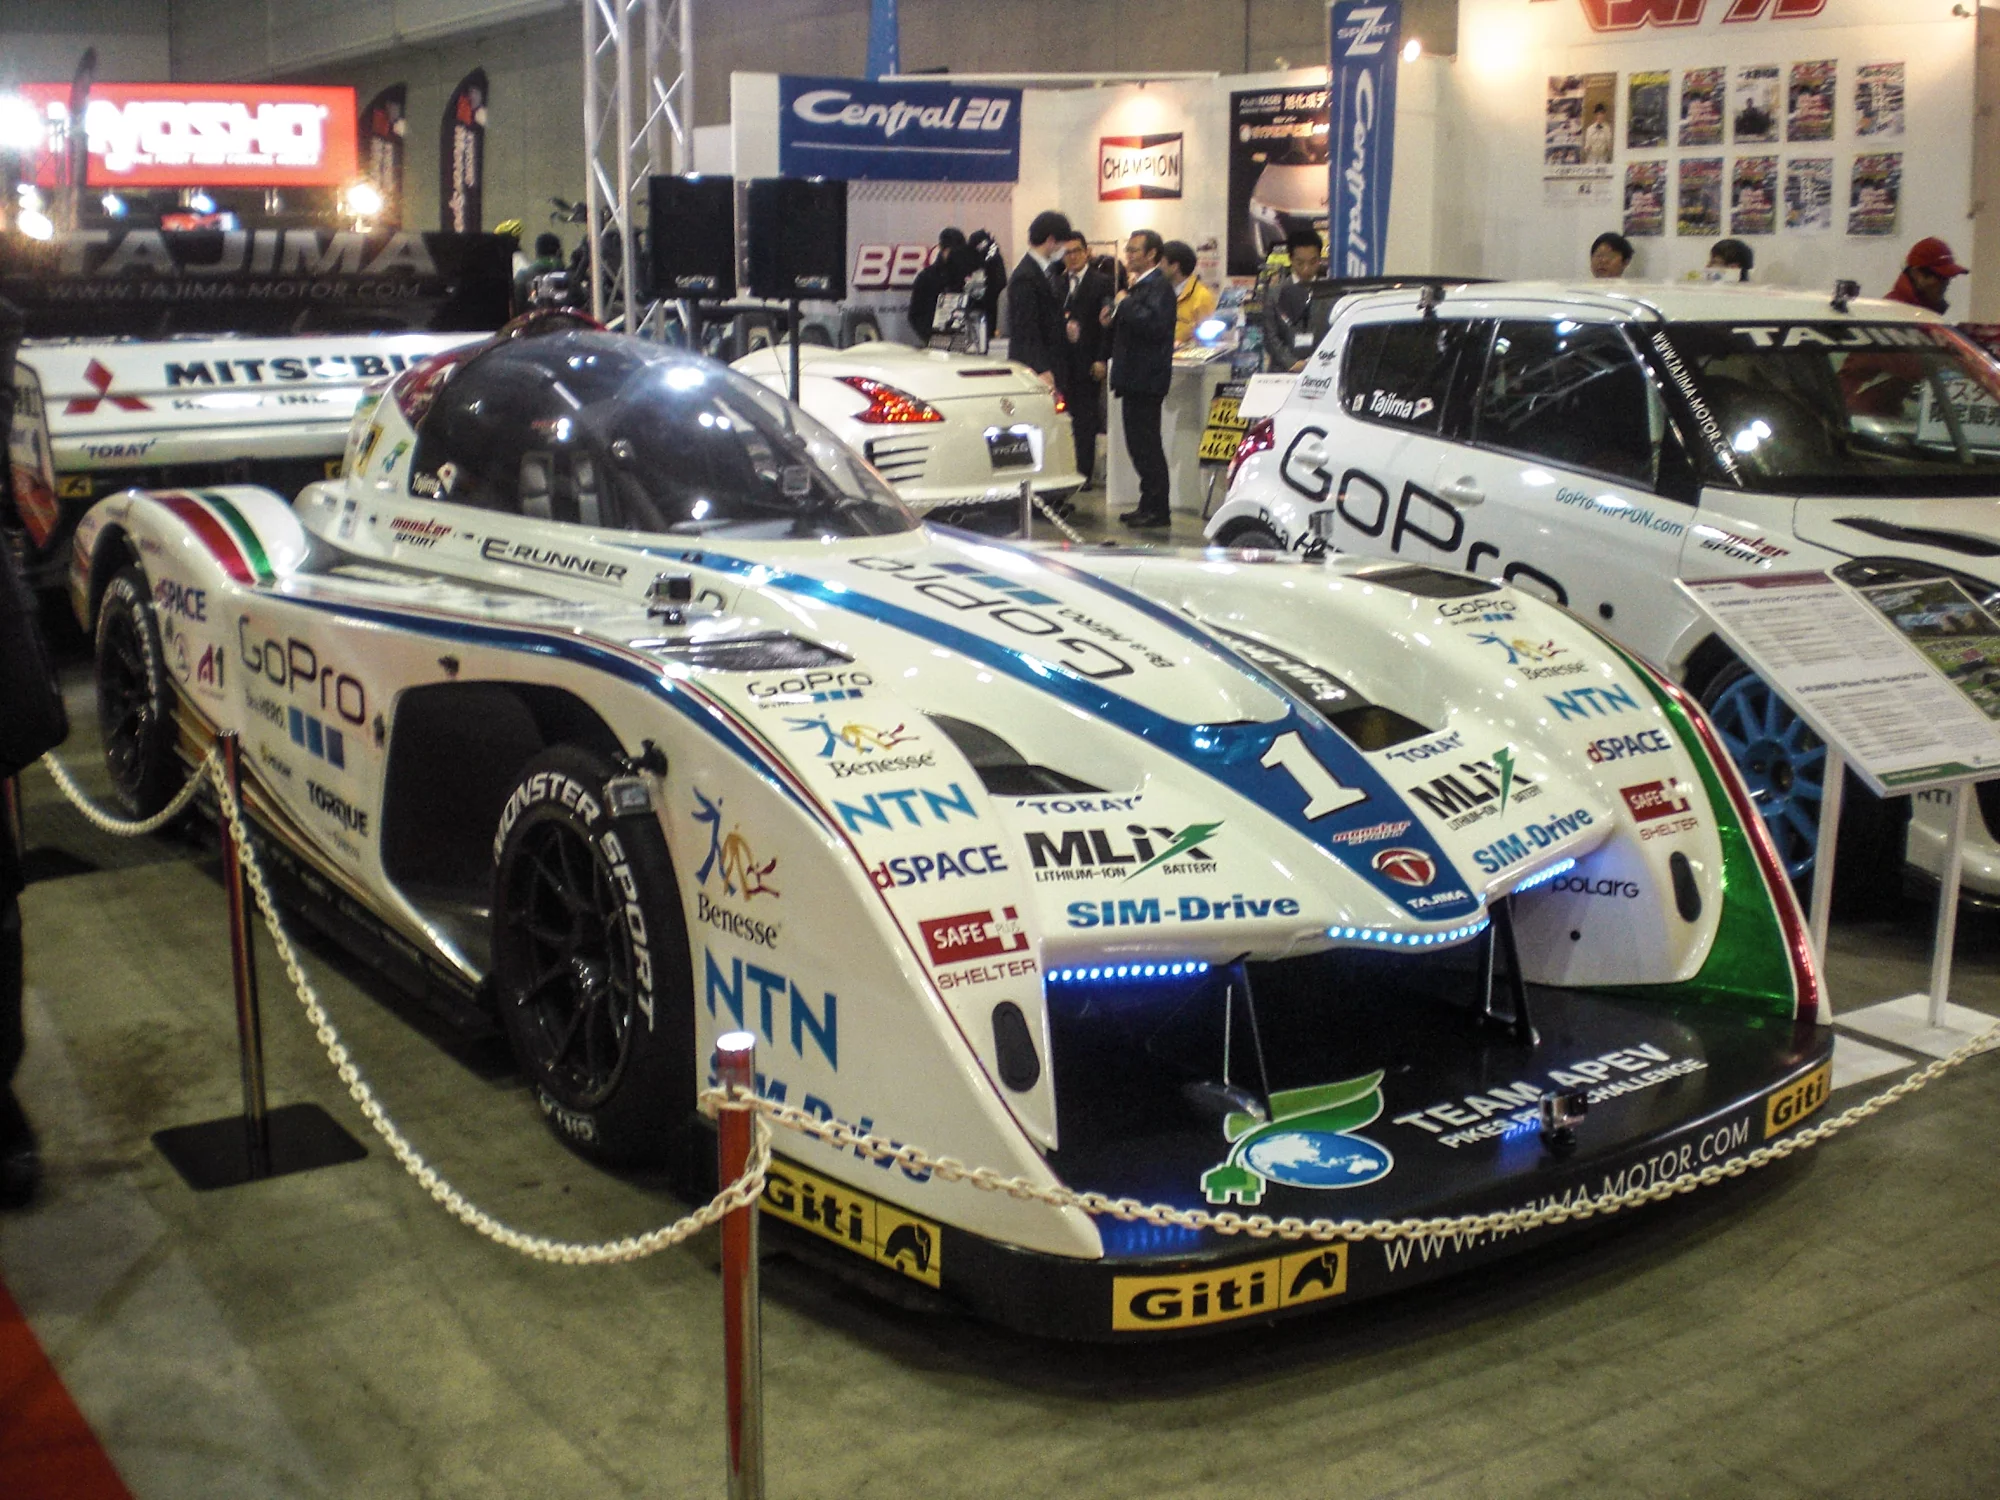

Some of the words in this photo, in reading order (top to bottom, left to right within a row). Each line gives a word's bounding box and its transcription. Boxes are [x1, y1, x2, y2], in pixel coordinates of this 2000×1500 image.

[1337, 23, 1393, 40] SPRT
[793, 90, 956, 137] Central
[957, 99, 1010, 130] 20
[1103, 151, 1180, 181] CHAMPION
[59, 229, 438, 275] TAJIMA
[1370, 389, 1414, 418] Tajima
[390, 516, 452, 538] monster
[1279, 426, 1568, 606] GoPro
[1556, 487, 1684, 537] GoPro-NIPPON.com
[393, 532, 438, 549] SPORT
[1700, 540, 1767, 565] SPORT
[848, 557, 1135, 679] GoPro
[1438, 599, 1516, 618] GoPro
[239, 615, 366, 726] GoPro
[746, 671, 874, 699] GoPro
[1517, 660, 1591, 680] Benesse
[1544, 683, 1642, 721] NTN
[825, 751, 936, 779] Benesse
[1586, 729, 1672, 763] dSPACE
[1259, 730, 1368, 821] 1
[306, 779, 369, 838] TORQUE
[493, 771, 600, 865] MONSTER
[828, 783, 980, 836] NTN
[1629, 791, 1662, 811] SAFE
[1471, 808, 1594, 875] SIM-Drive
[1639, 817, 1698, 841] SHELTER
[870, 845, 1008, 891] dSPACE
[1035, 867, 1126, 883] LITHIUM-ION
[1163, 862, 1217, 876] BATTERY
[1066, 894, 1301, 928] SIM-Drive
[1407, 889, 1469, 909] TAJIMA
[601, 830, 655, 1033] SPORT
[698, 893, 778, 950] Benesse
[933, 922, 985, 950] SAFE
[937, 958, 1038, 991] SHELTER
[705, 945, 838, 1074] NTN
[1392, 1080, 1543, 1134] TEAM
[1548, 1042, 1672, 1087] APEV
[1772, 1073, 1826, 1129] Giti
[1437, 1119, 1518, 1149] PIKES
[762, 1172, 863, 1245] Giti
[1129, 1270, 1267, 1322] Giti
